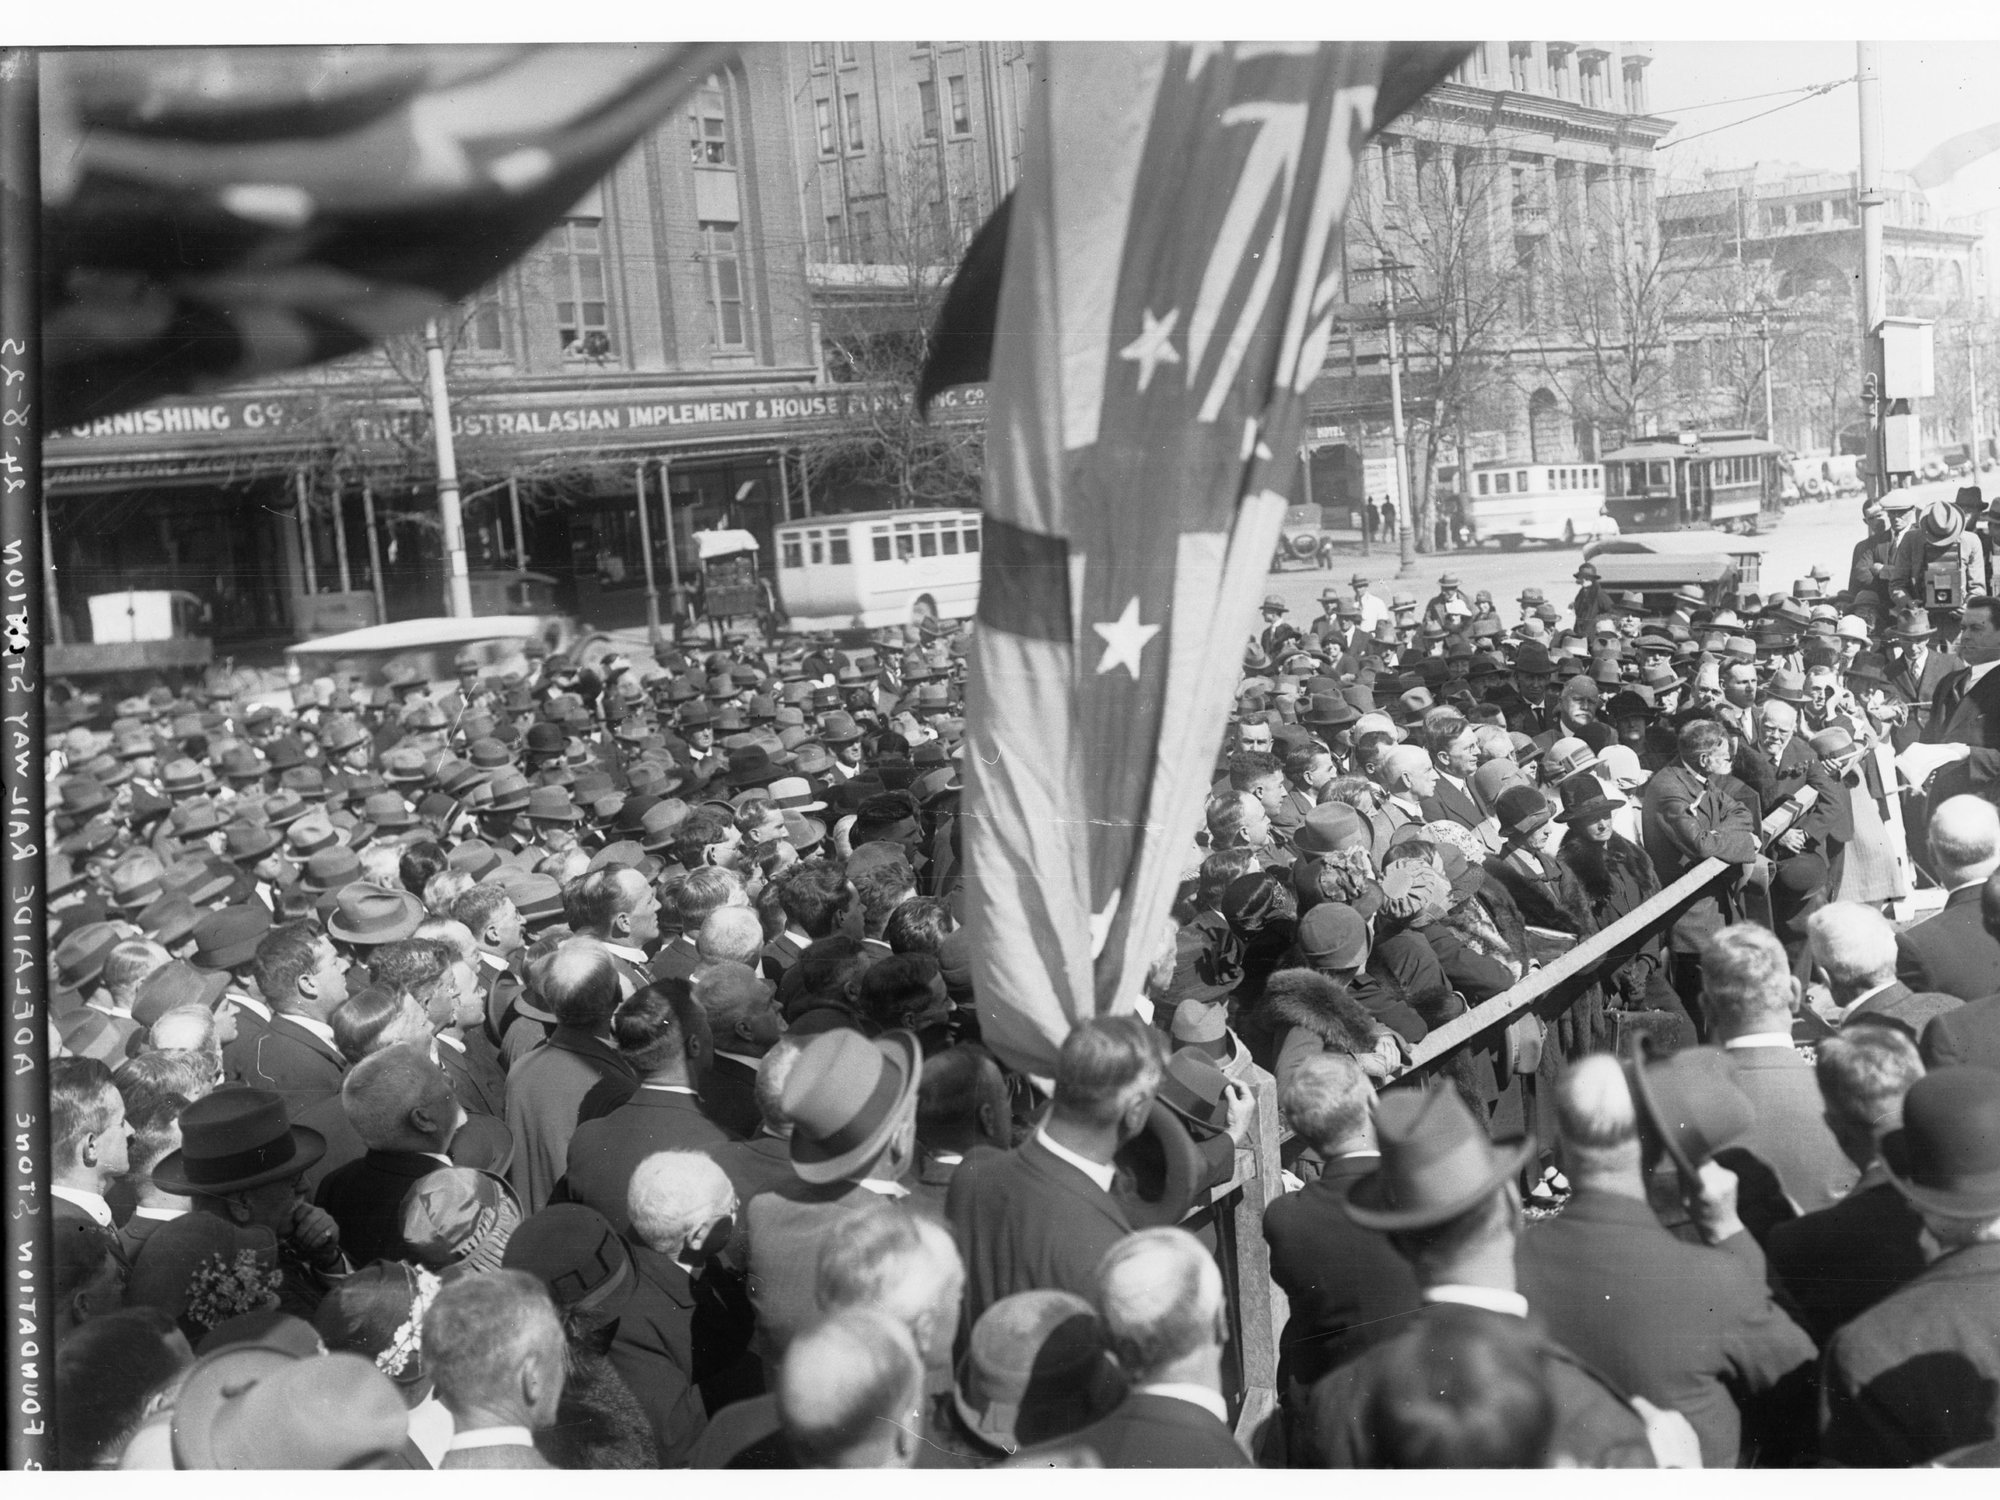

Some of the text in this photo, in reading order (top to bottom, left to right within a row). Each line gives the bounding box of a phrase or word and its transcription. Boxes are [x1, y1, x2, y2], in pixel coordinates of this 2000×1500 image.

[50, 406, 231, 438] URNISHING
[627, 401, 749, 427] IMPLEMENT
[755, 400, 767, 418] &
[770, 397, 838, 418] HOUSE
